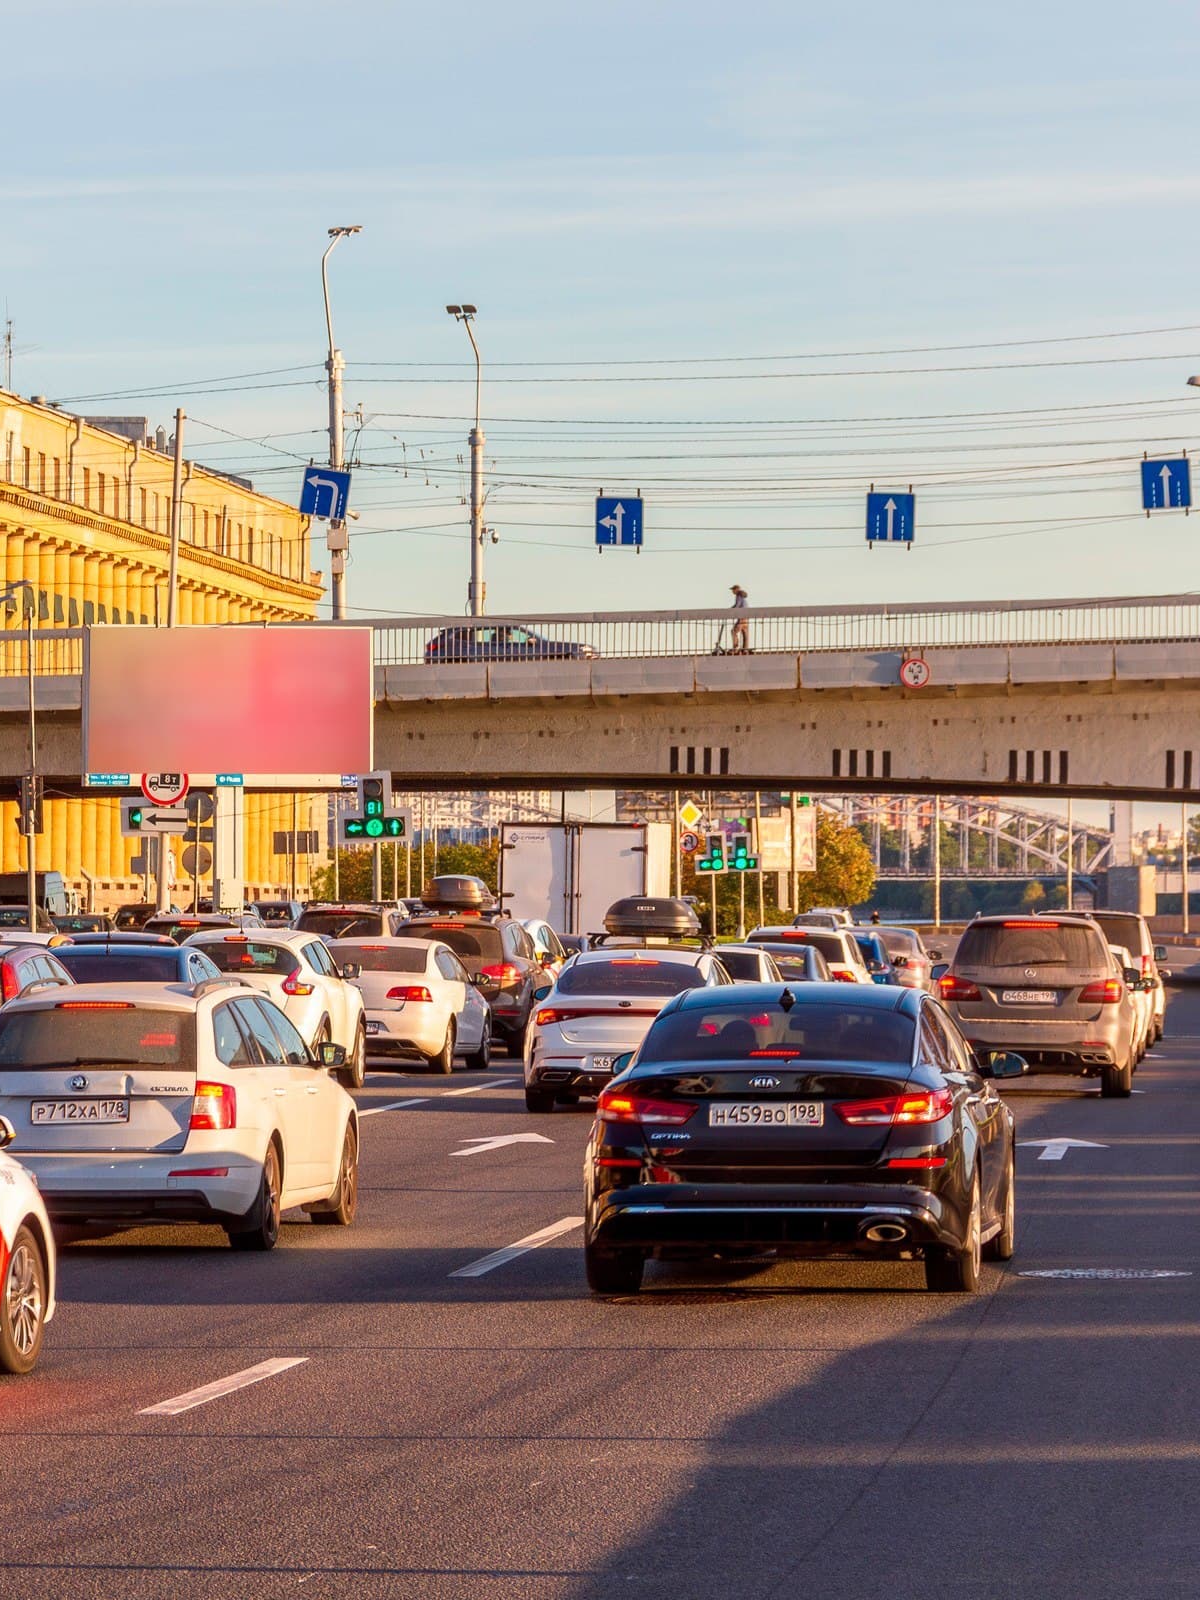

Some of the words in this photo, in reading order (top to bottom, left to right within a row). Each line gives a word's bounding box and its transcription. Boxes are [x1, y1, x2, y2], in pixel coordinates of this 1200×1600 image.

[367, 801, 381, 815] 81
[753, 1077, 774, 1087] KIA
[37, 1103, 98, 1119] Р712ХА
[101, 1101, 124, 1114] 178
[715, 1105, 786, 1123] Н459ВО
[790, 1104, 816, 1119] 198
